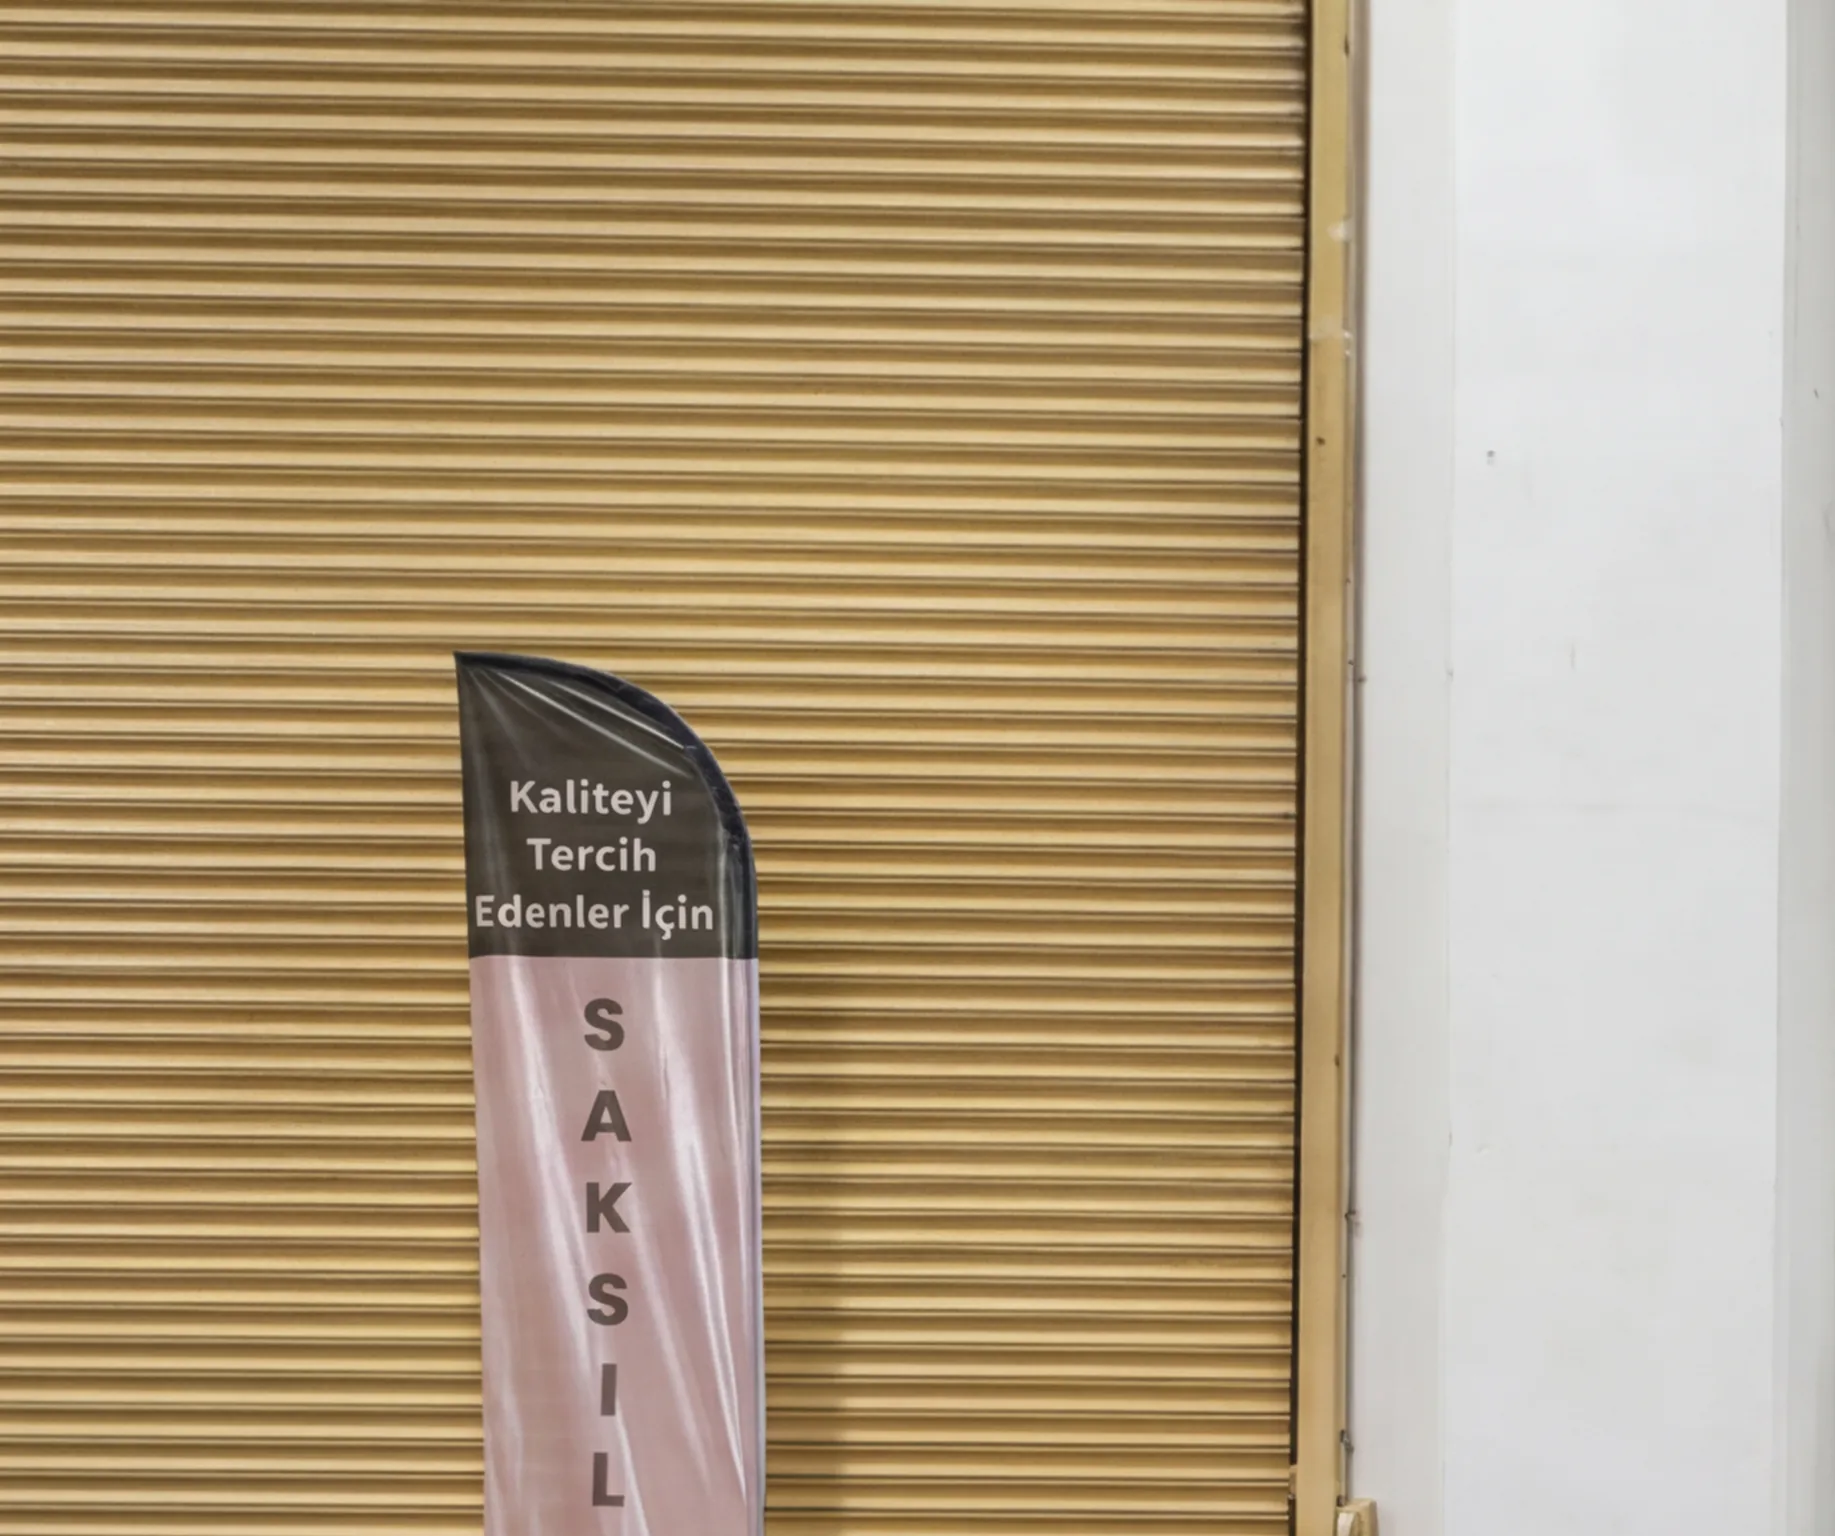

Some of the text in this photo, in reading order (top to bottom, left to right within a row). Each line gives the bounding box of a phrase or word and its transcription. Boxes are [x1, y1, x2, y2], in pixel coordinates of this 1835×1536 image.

[510, 779, 672, 824] Kaliteyi
[526, 836, 657, 872] Tercih
[475, 889, 714, 940] Edenler İçin
